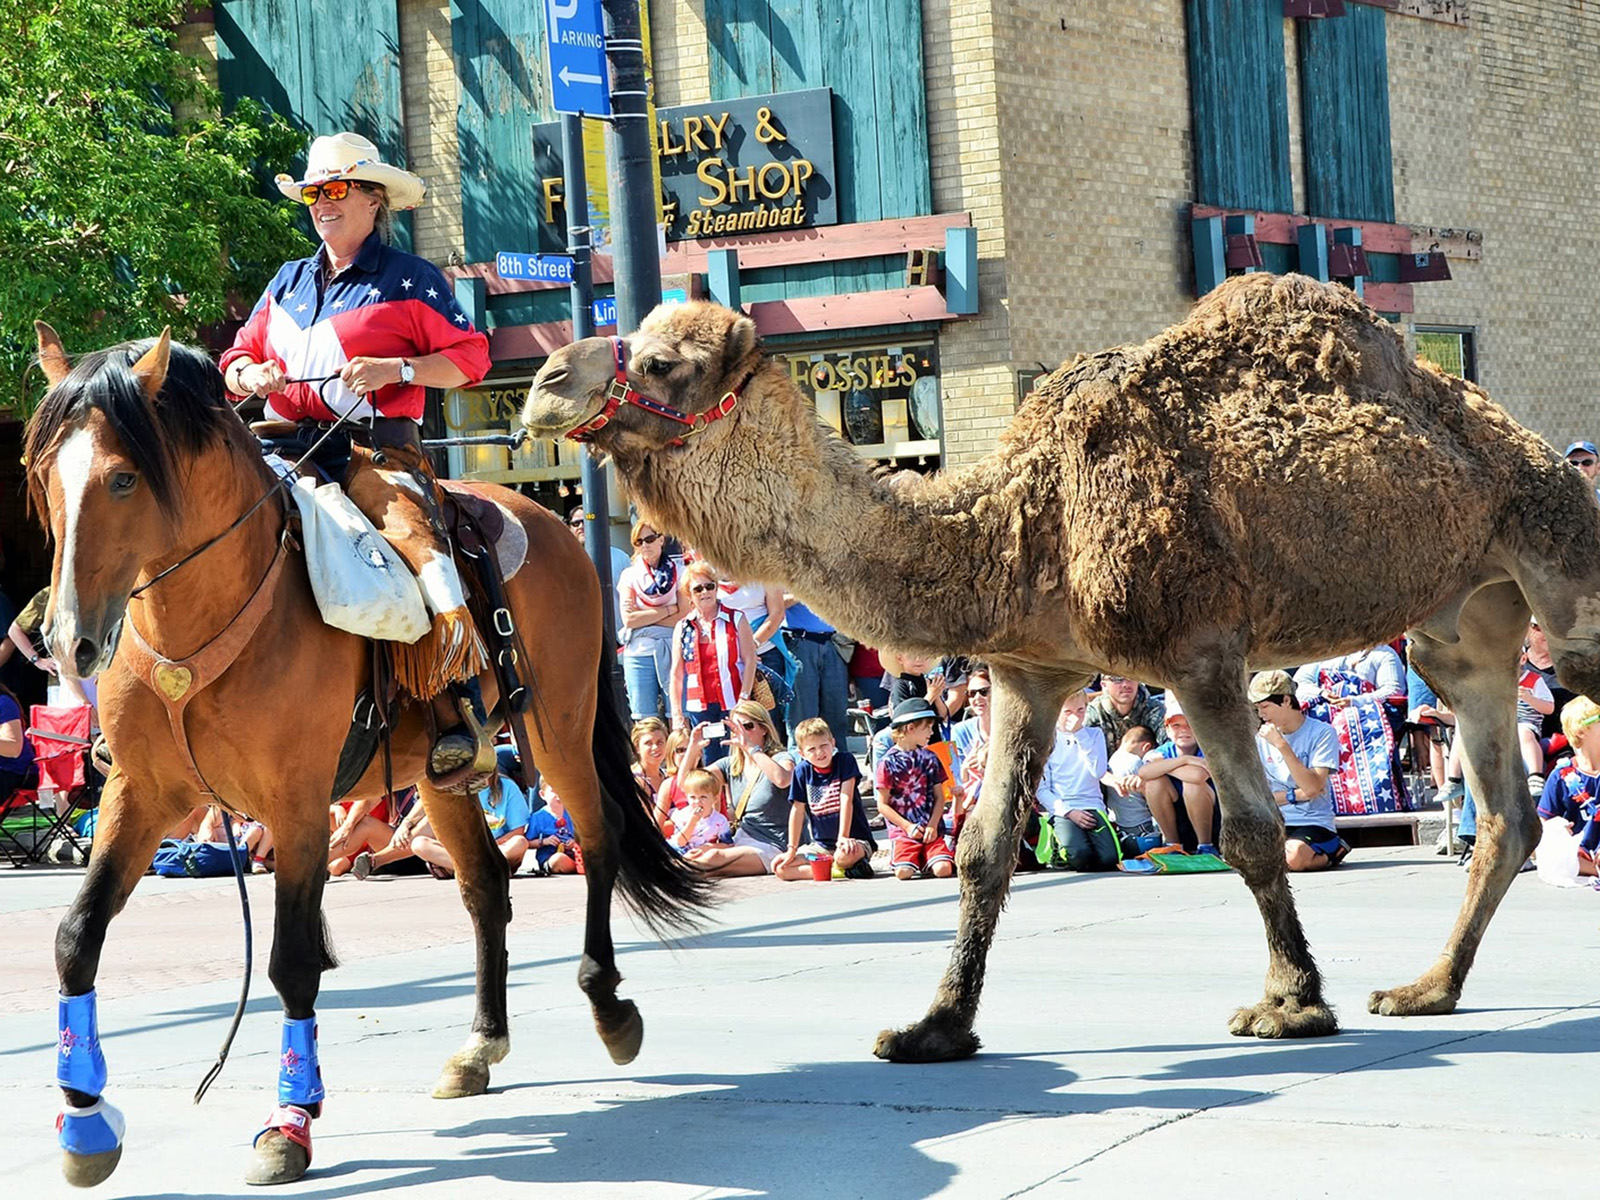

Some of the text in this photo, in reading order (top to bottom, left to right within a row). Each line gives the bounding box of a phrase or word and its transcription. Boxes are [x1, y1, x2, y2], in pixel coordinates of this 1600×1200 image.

[658, 106, 787, 155] LRY &
[696, 157, 813, 207] SHOP
[687, 200, 804, 235] Steamboat
[499, 255, 572, 279] 8th Street
[594, 303, 616, 323] Lin
[787, 353, 917, 393] FOSSILS
[443, 388, 530, 431] CRYST
